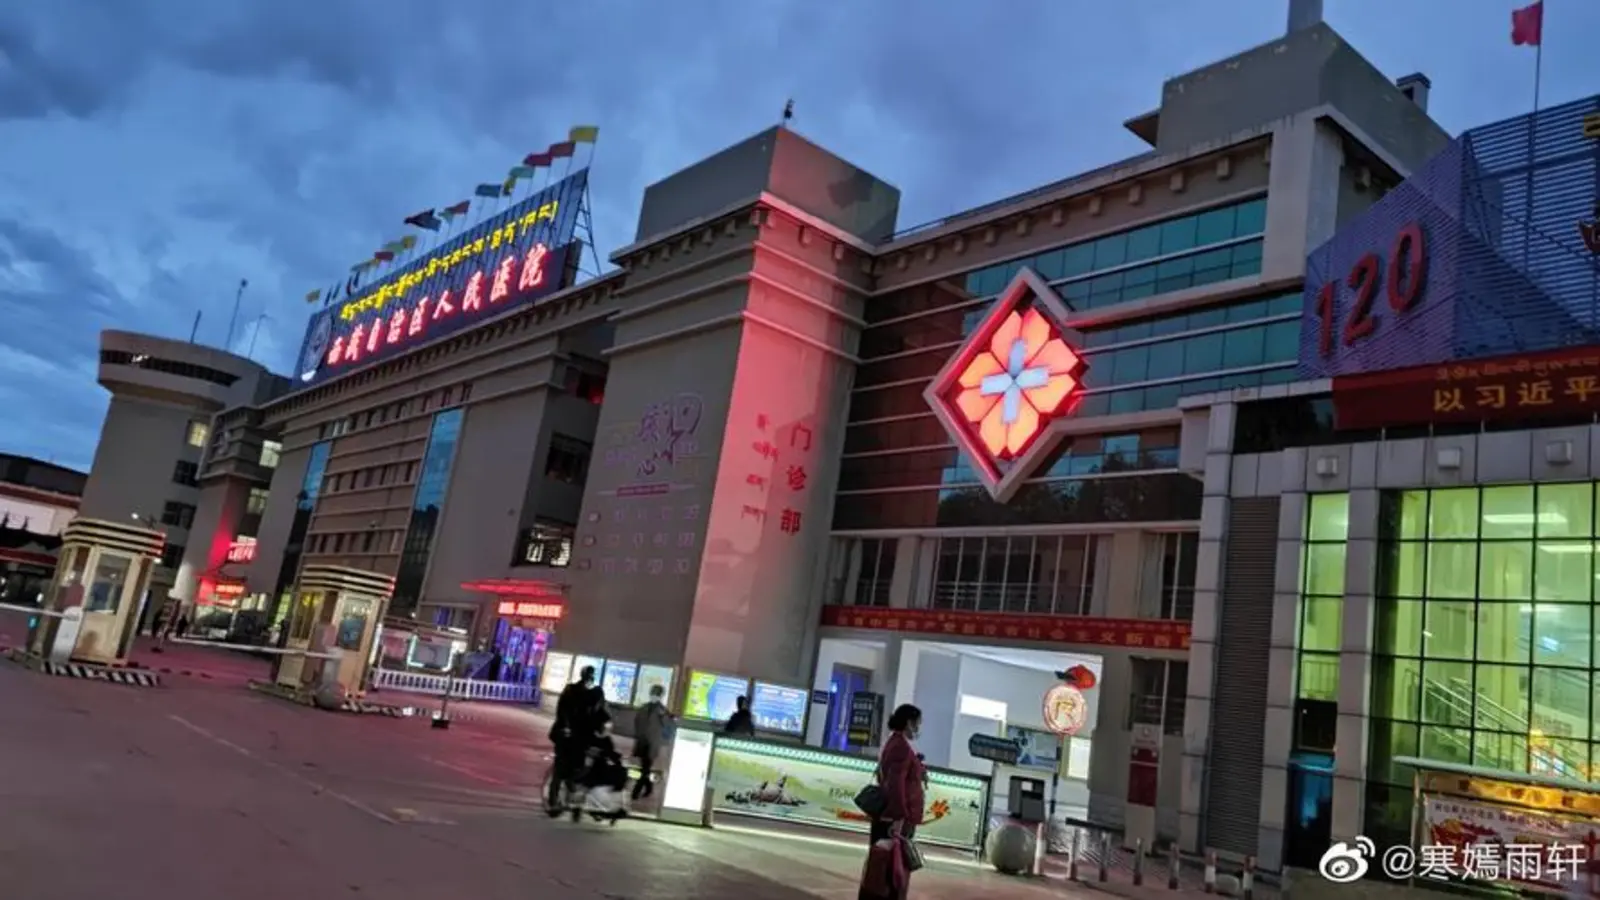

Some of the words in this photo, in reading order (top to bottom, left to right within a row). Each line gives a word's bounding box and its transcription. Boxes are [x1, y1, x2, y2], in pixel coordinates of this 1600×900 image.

[327, 243, 548, 365] 西藏自治区人民医院
[1315, 221, 1425, 359] 120
[1432, 375, 1600, 412] 以习近平
[779, 424, 812, 536] 门诊部
